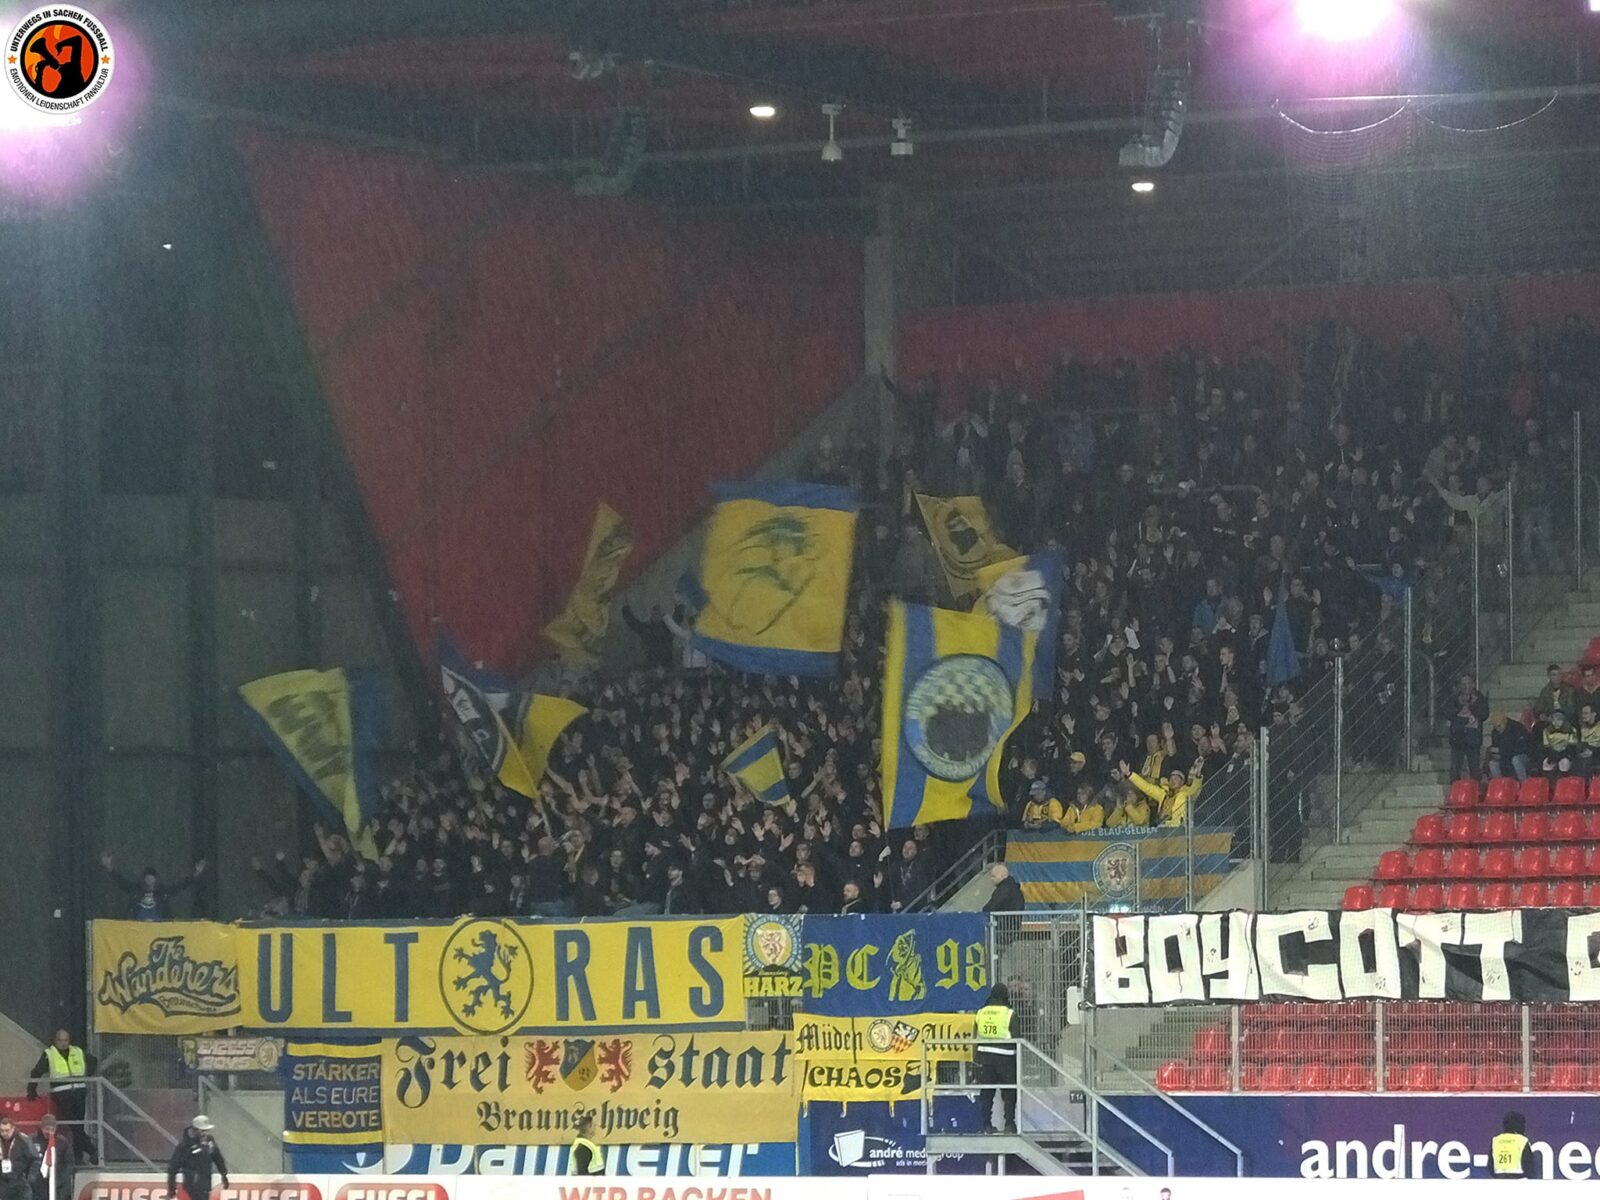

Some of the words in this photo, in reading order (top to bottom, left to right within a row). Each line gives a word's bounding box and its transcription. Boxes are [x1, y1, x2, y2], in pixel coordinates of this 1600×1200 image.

[935, 938, 987, 993] 98
[1093, 907, 1523, 1006] BOYCOTT
[98, 951, 240, 1014] Wanderers
[744, 976, 804, 997] HARZ
[795, 1023, 864, 1055] Müden
[983, 1024, 998, 1035] 378
[292, 1058, 380, 1082] STÄRKER
[395, 1034, 512, 1110] Frei
[808, 1065, 902, 1089] CHAOS
[291, 1086, 328, 1105] ALS
[330, 1085, 379, 1104] EURE
[291, 1110, 380, 1129] VERBOTE
[869, 1146, 903, 1159] andré
